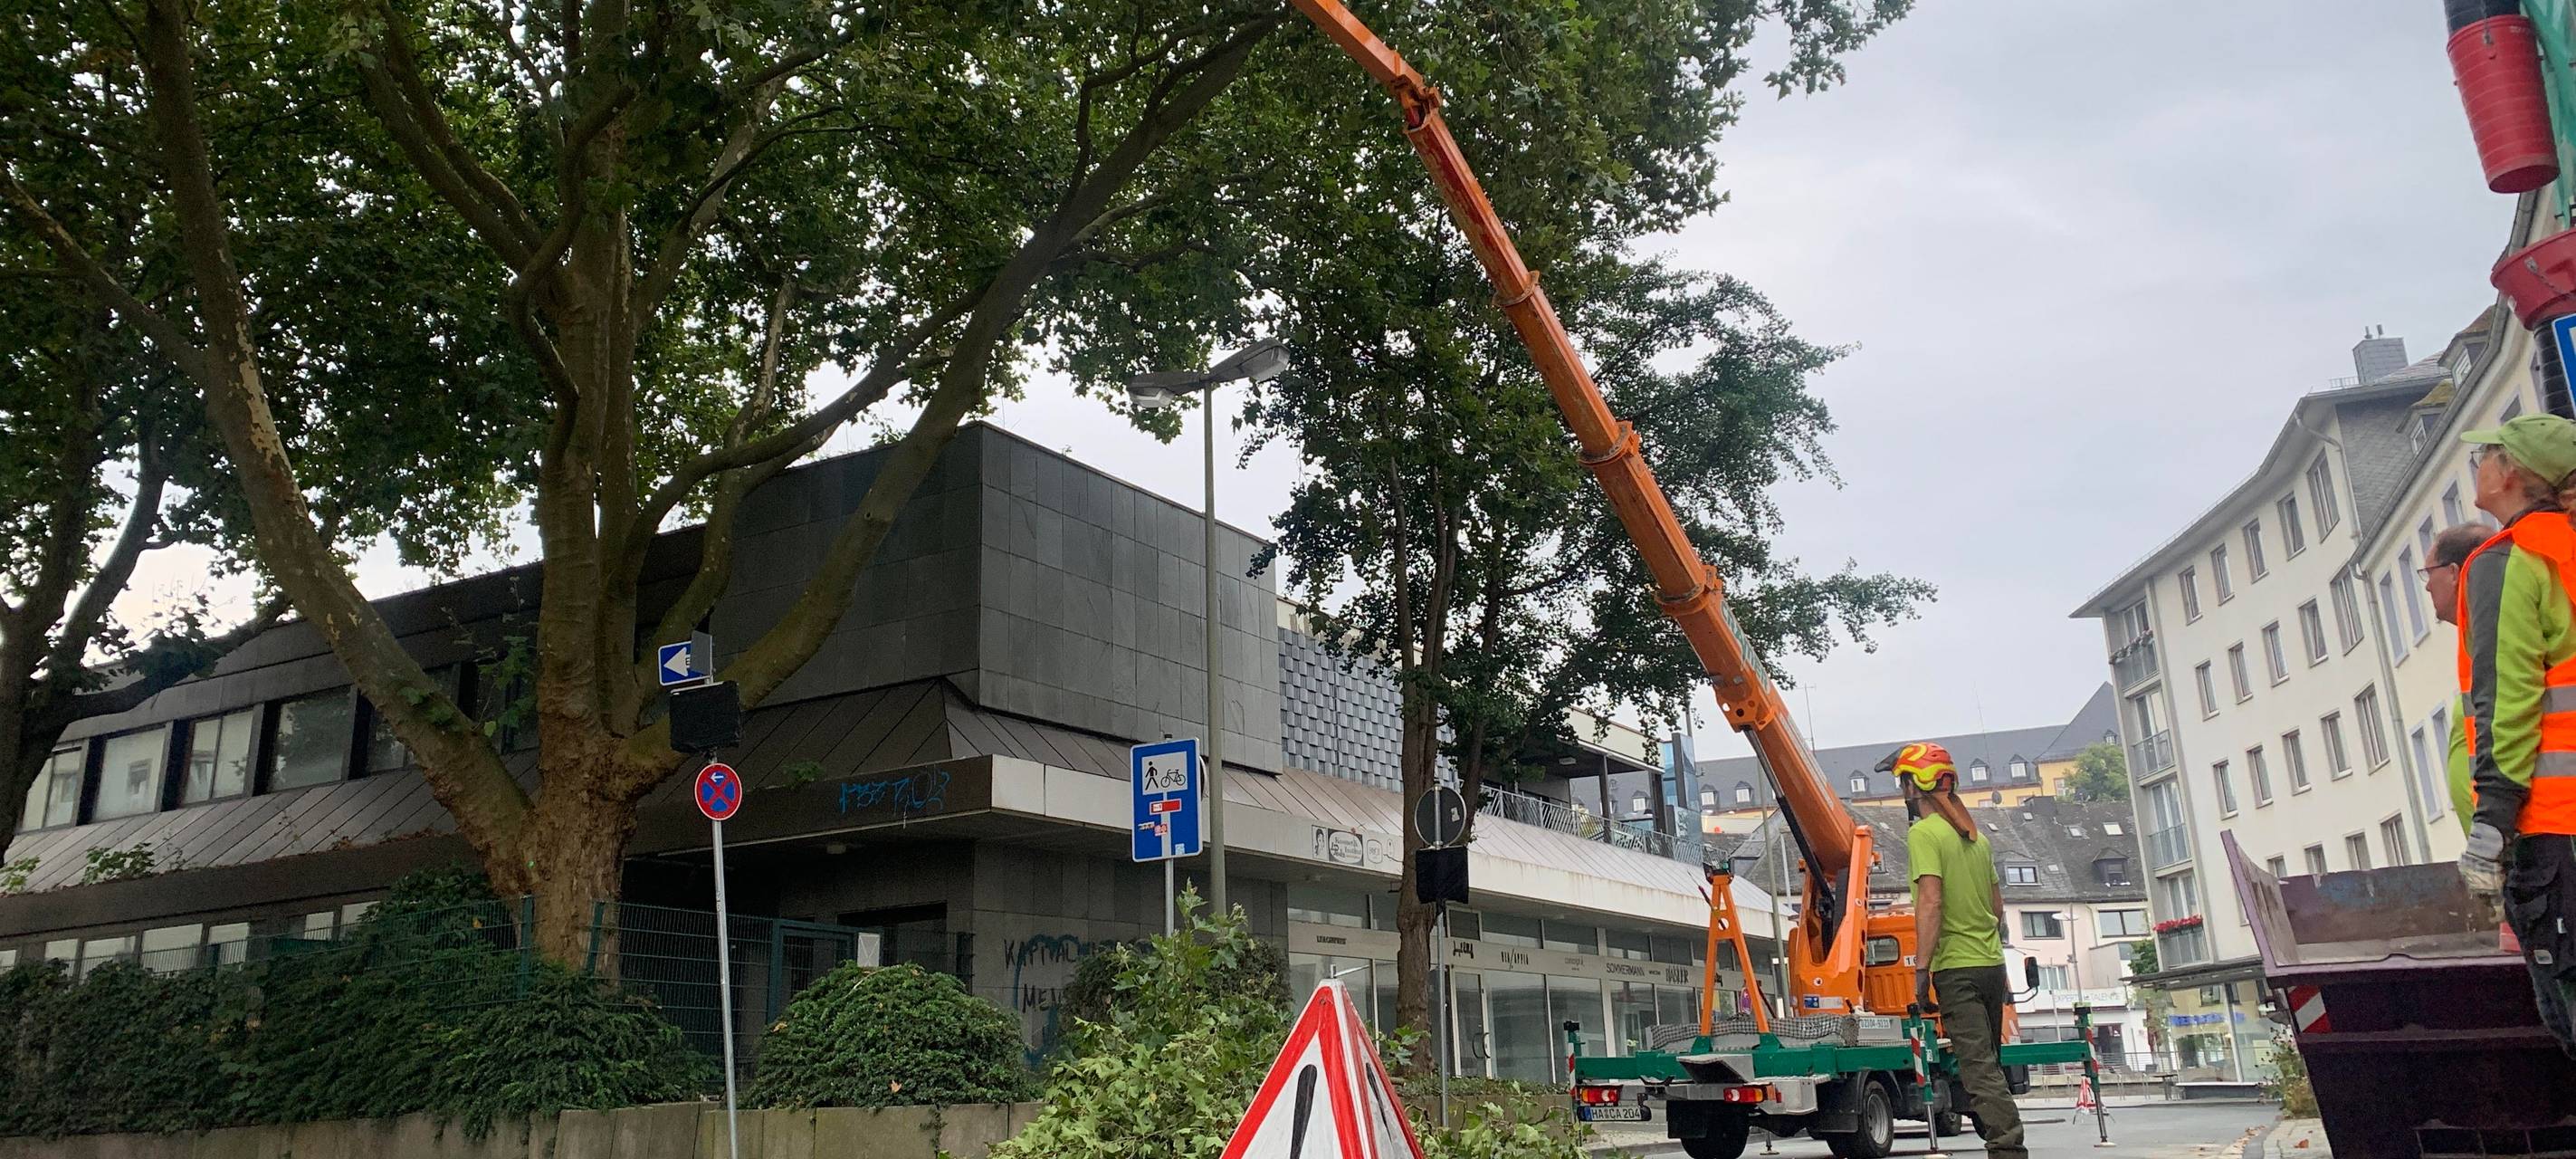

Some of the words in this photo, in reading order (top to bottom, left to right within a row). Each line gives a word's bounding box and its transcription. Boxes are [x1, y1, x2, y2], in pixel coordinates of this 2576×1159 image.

[1591, 1107, 1604, 1119] HA
[1608, 1108, 1622, 1119] CA
[1622, 1108, 1640, 1119] 204
